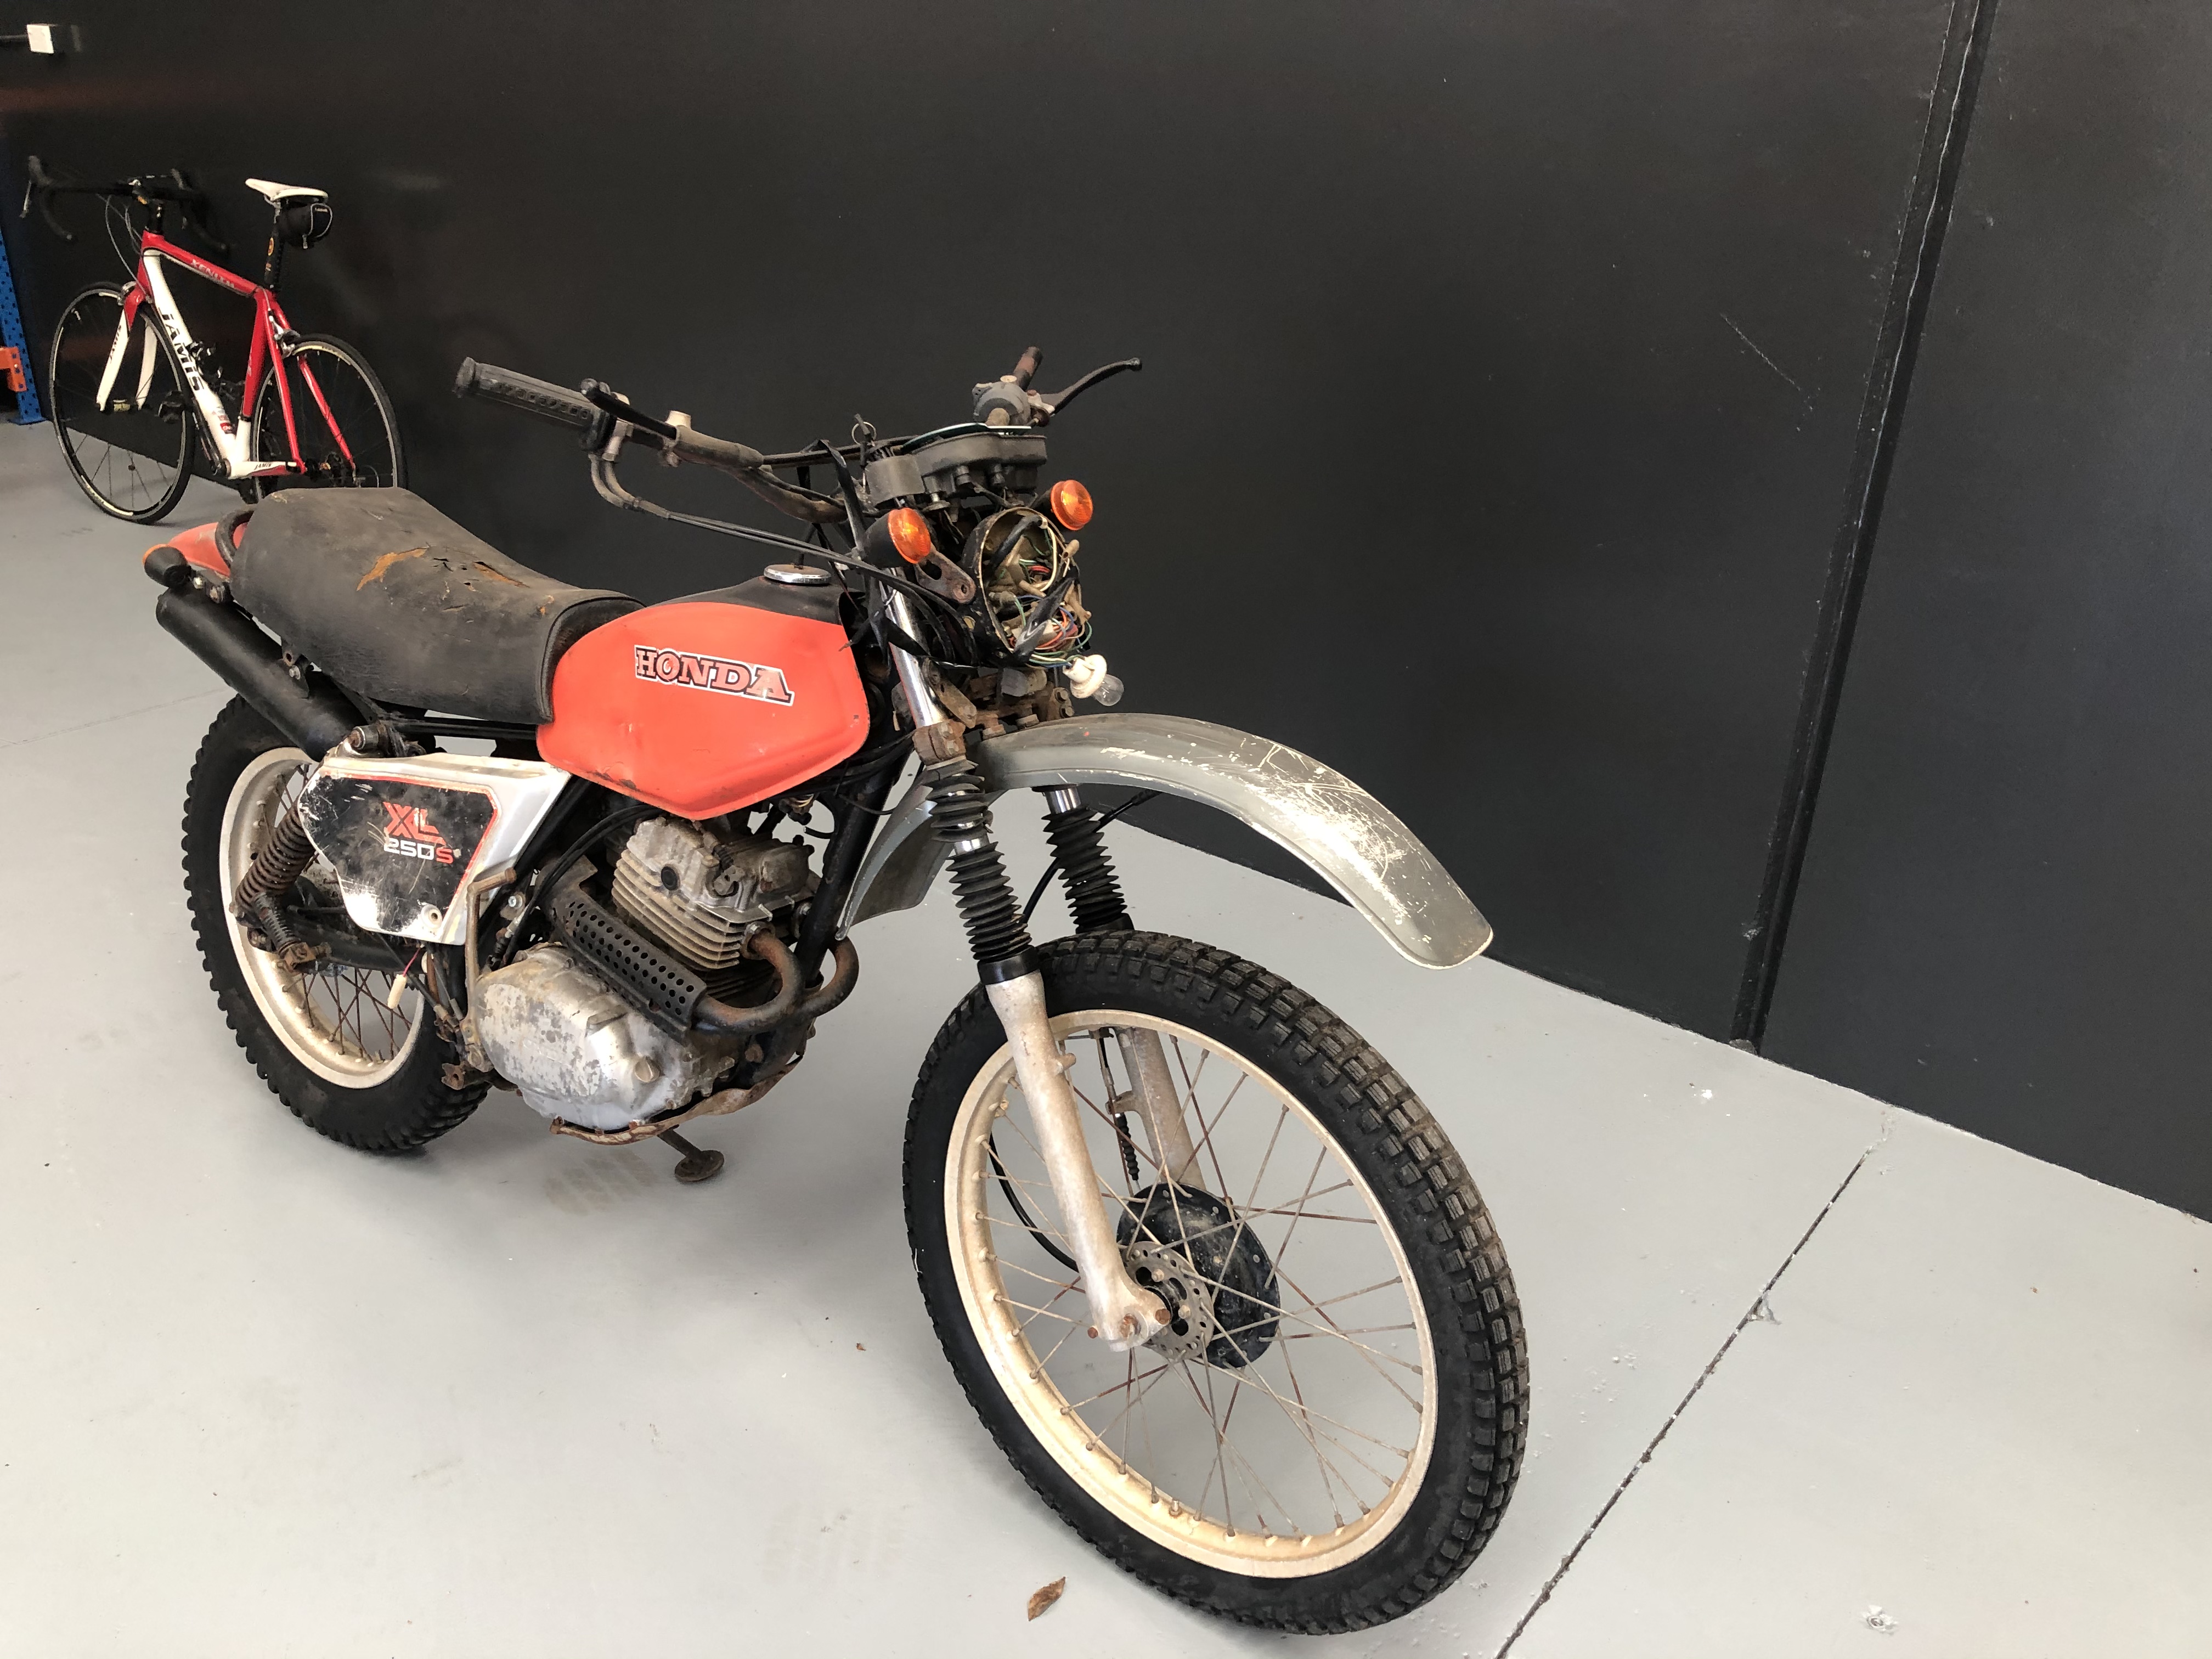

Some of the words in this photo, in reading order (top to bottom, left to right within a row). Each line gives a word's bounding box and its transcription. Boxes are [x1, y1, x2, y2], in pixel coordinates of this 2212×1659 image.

[158, 307, 205, 391] JAMIS
[635, 646, 794, 705] HONDA
[382, 801, 447, 845] XL
[383, 840, 454, 865] 250S
